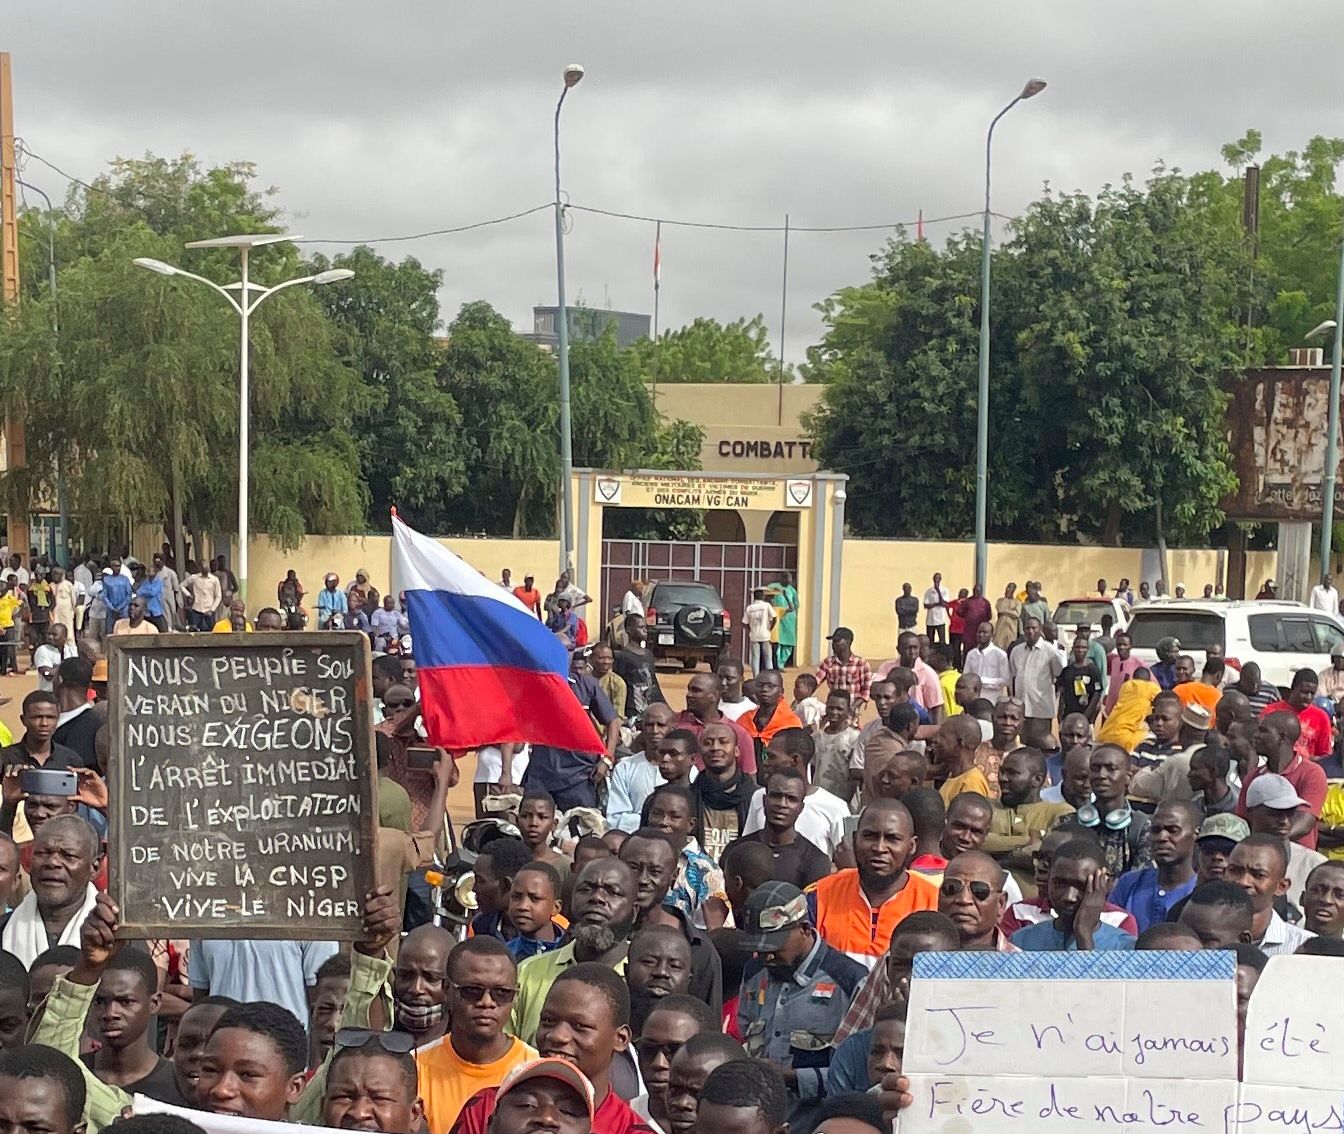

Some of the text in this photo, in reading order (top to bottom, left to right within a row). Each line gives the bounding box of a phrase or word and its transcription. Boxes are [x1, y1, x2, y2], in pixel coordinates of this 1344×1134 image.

[718, 440, 815, 459] COMBATT
[128, 656, 198, 687] NOUS
[125, 693, 210, 717] VERAIN
[220, 693, 248, 714] DU
[128, 724, 191, 747] NOUS
[131, 805, 168, 826] DE
[131, 846, 161, 863] DE
[235, 864, 256, 887] LA
[269, 865, 348, 888] CNSP
[240, 892, 265, 915] LE
[925, 1006, 1005, 1066] Je
[1131, 1033, 1230, 1065] jamais
[1039, 1083, 1085, 1120] de
[1095, 1089, 1206, 1126] notre
